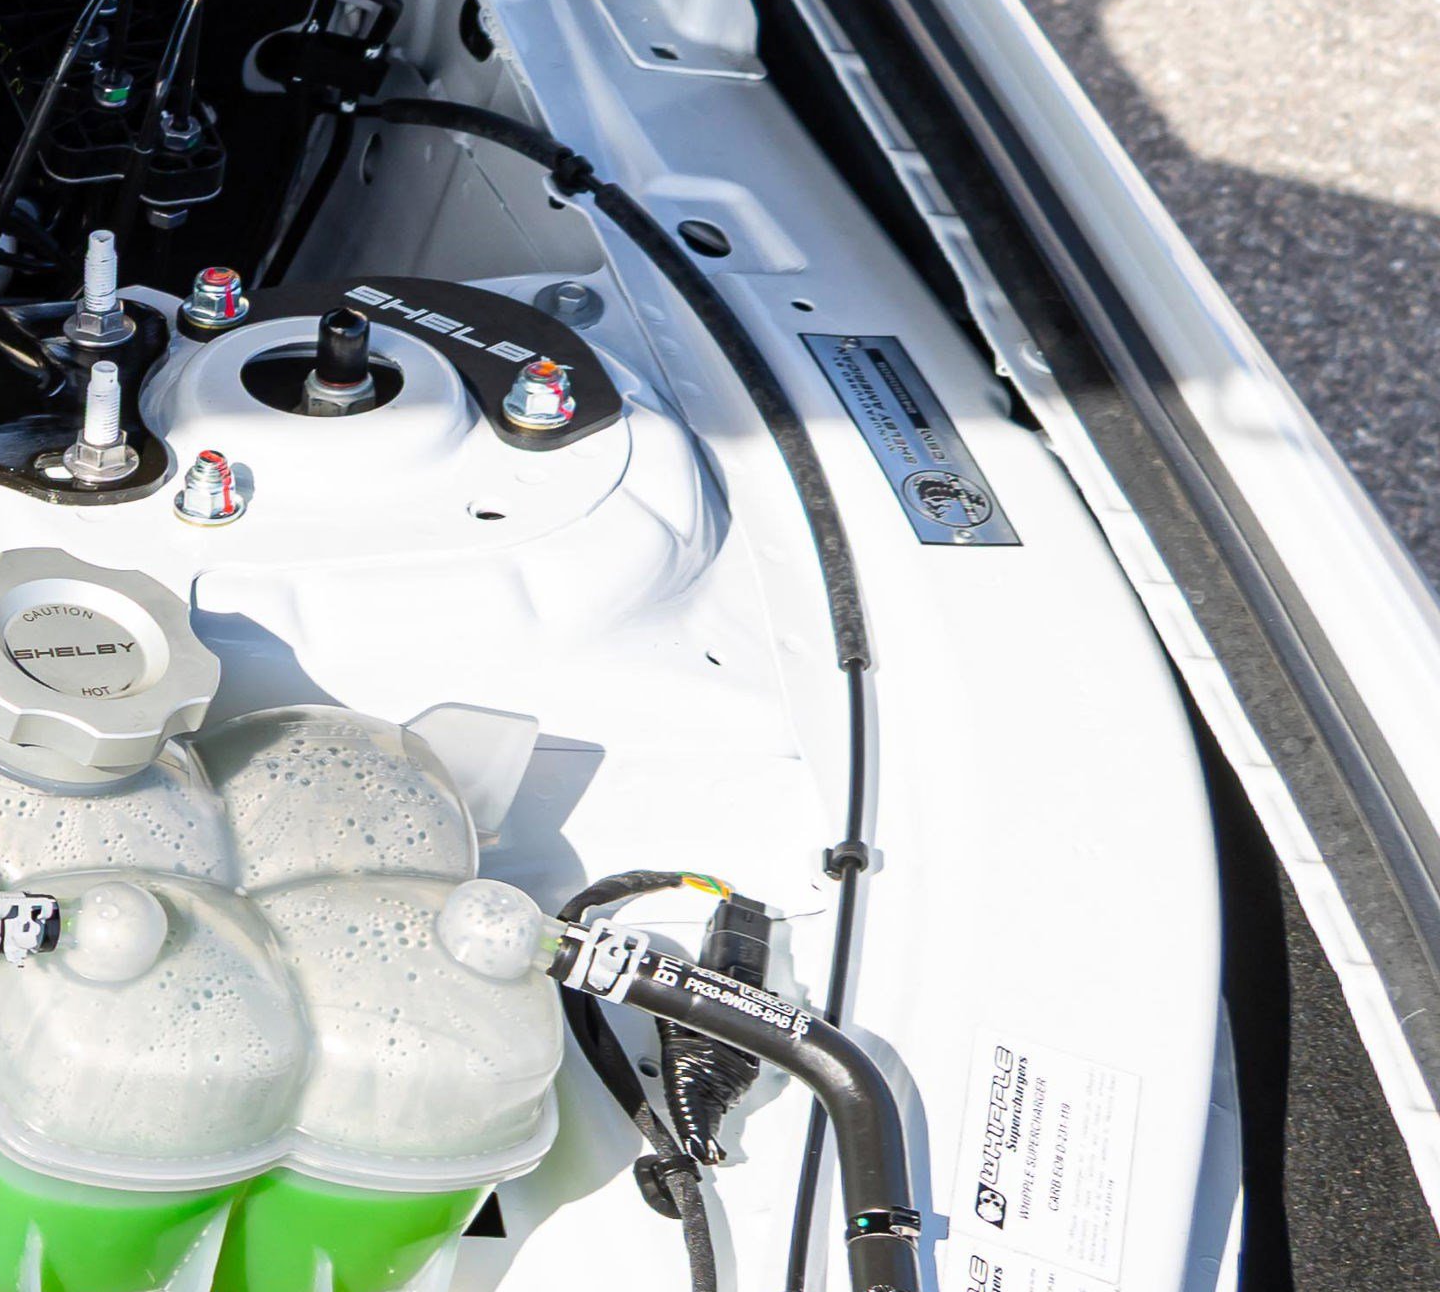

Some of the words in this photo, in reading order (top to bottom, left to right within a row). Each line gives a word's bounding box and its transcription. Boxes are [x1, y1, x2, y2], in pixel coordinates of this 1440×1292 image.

[344, 285, 574, 370] SHELB
[833, 345, 886, 409] AMERICAN
[877, 416, 919, 463] SHELBY
[22, 605, 94, 623] CAUTION
[13, 641, 136, 661] SHELBY
[81, 685, 111, 697] HOT
[975, 1044, 1017, 1185] WHIPPLE
[1003, 1054, 1032, 1153] Superchargers
[1023, 1075, 1048, 1168] SUPERCHARGER
[1016, 1168, 1035, 1220] WHIPPLE
[1047, 1178, 1062, 1212] CARB
